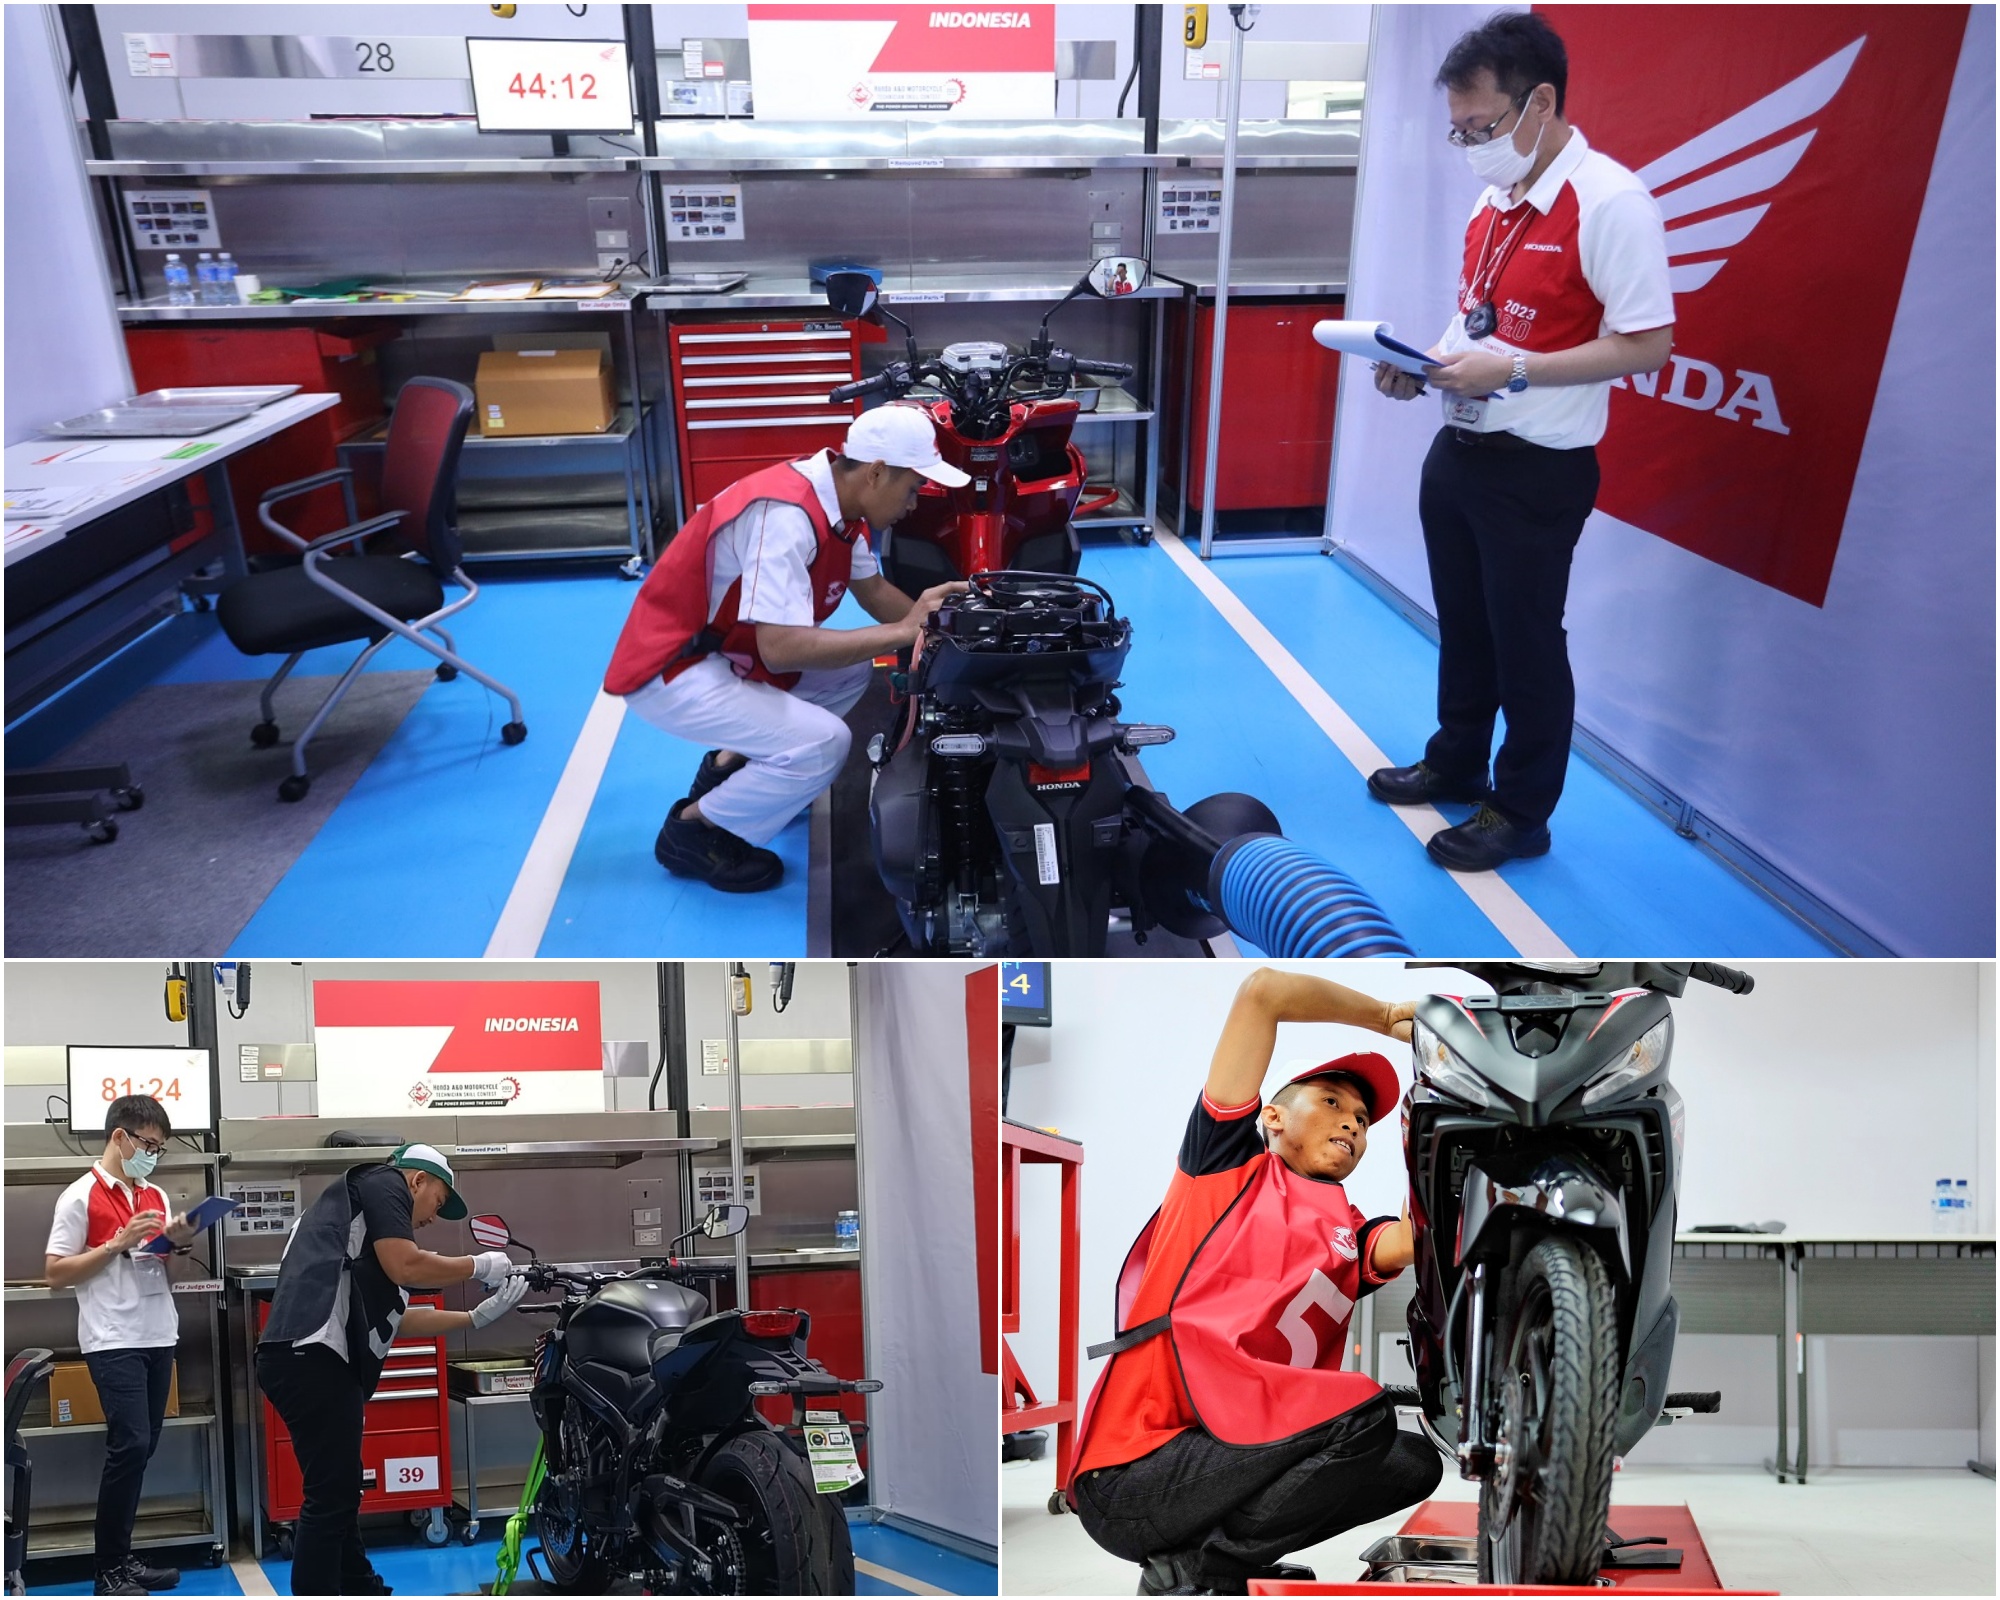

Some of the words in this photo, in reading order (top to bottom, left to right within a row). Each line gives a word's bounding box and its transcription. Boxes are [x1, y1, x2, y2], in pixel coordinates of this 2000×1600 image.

[928, 11, 1031, 28] INDONESIA
[355, 42, 394, 72] 28
[508, 72, 598, 99] 44:12
[1524, 243, 1562, 252] HONDA
[1504, 299, 1536, 320] 2023
[1036, 782, 1081, 791] HONDA
[484, 1017, 579, 1032] INDONESIA
[399, 1467, 424, 1483] 39
